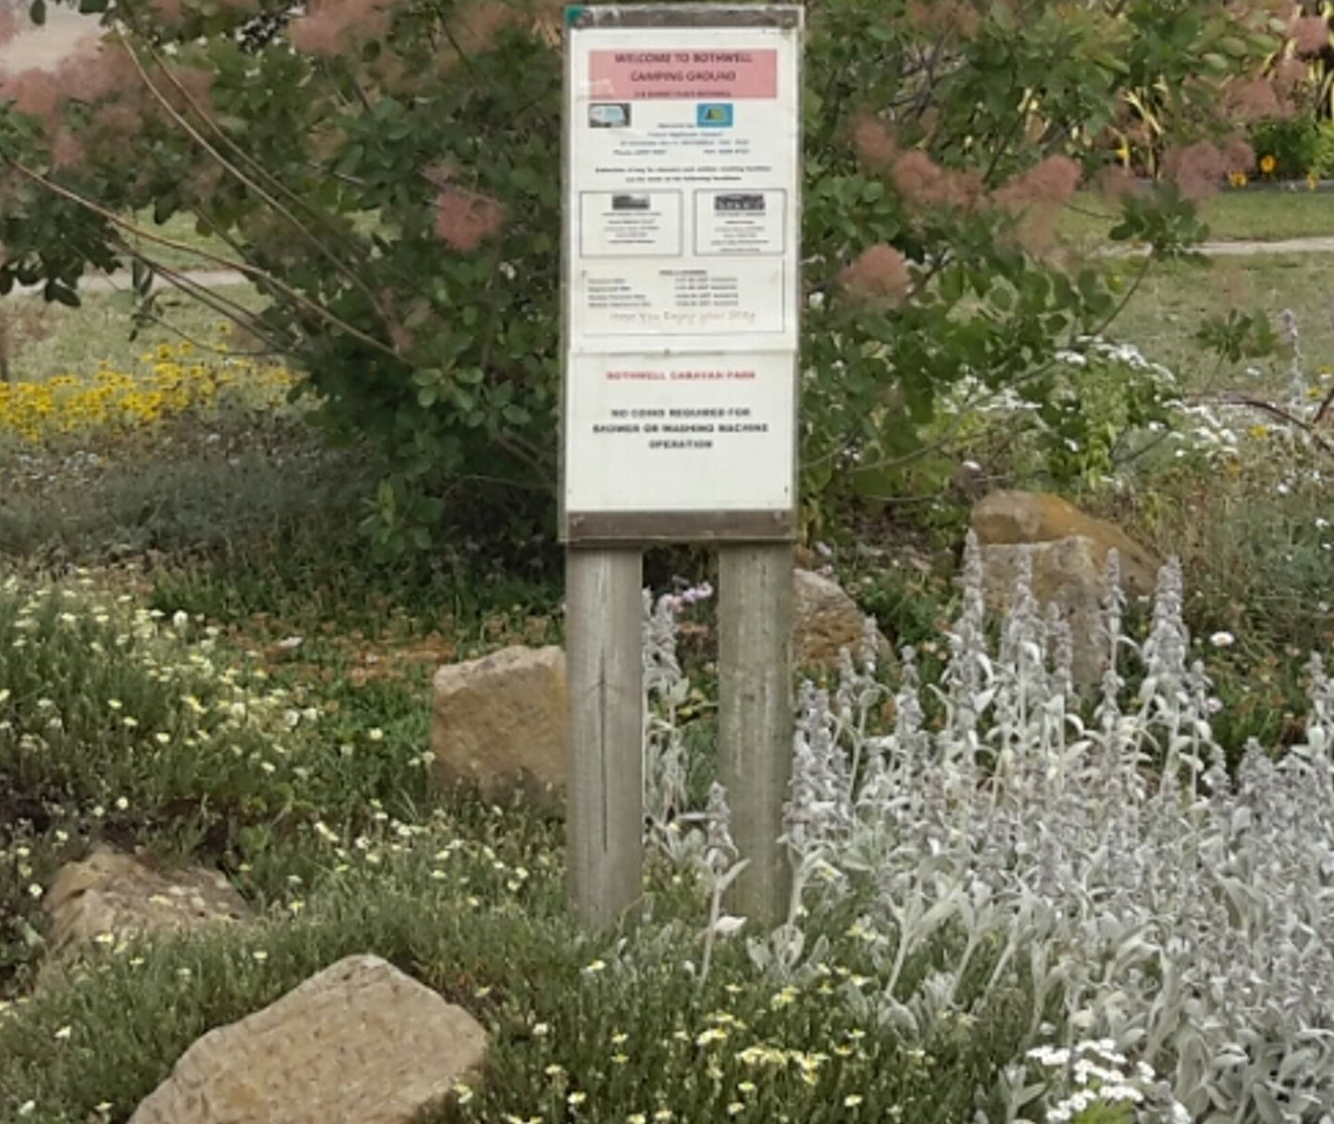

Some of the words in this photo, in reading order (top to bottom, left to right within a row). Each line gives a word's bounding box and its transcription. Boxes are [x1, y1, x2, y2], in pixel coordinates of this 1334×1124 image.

[614, 53, 671, 63] WELCOME
[676, 53, 689, 63] TO
[693, 53, 753, 63] BOTHWELL
[630, 71, 683, 82] CAMPING
[686, 71, 736, 82] GROUND
[606, 371, 666, 380] BOTHWELL
[670, 371, 723, 380] CARAVAN
[727, 371, 756, 380] PARK
[611, 409, 628, 418] NO
[631, 409, 665, 418] COINS
[669, 409, 725, 418] REQUIRED
[728, 408, 750, 417] FOR
[593, 424, 640, 433] SHOWER
[643, 424, 659, 433] OR
[662, 424, 714, 433] WASHING
[718, 423, 769, 433] MACHINE
[648, 440, 713, 449] OPERATION
